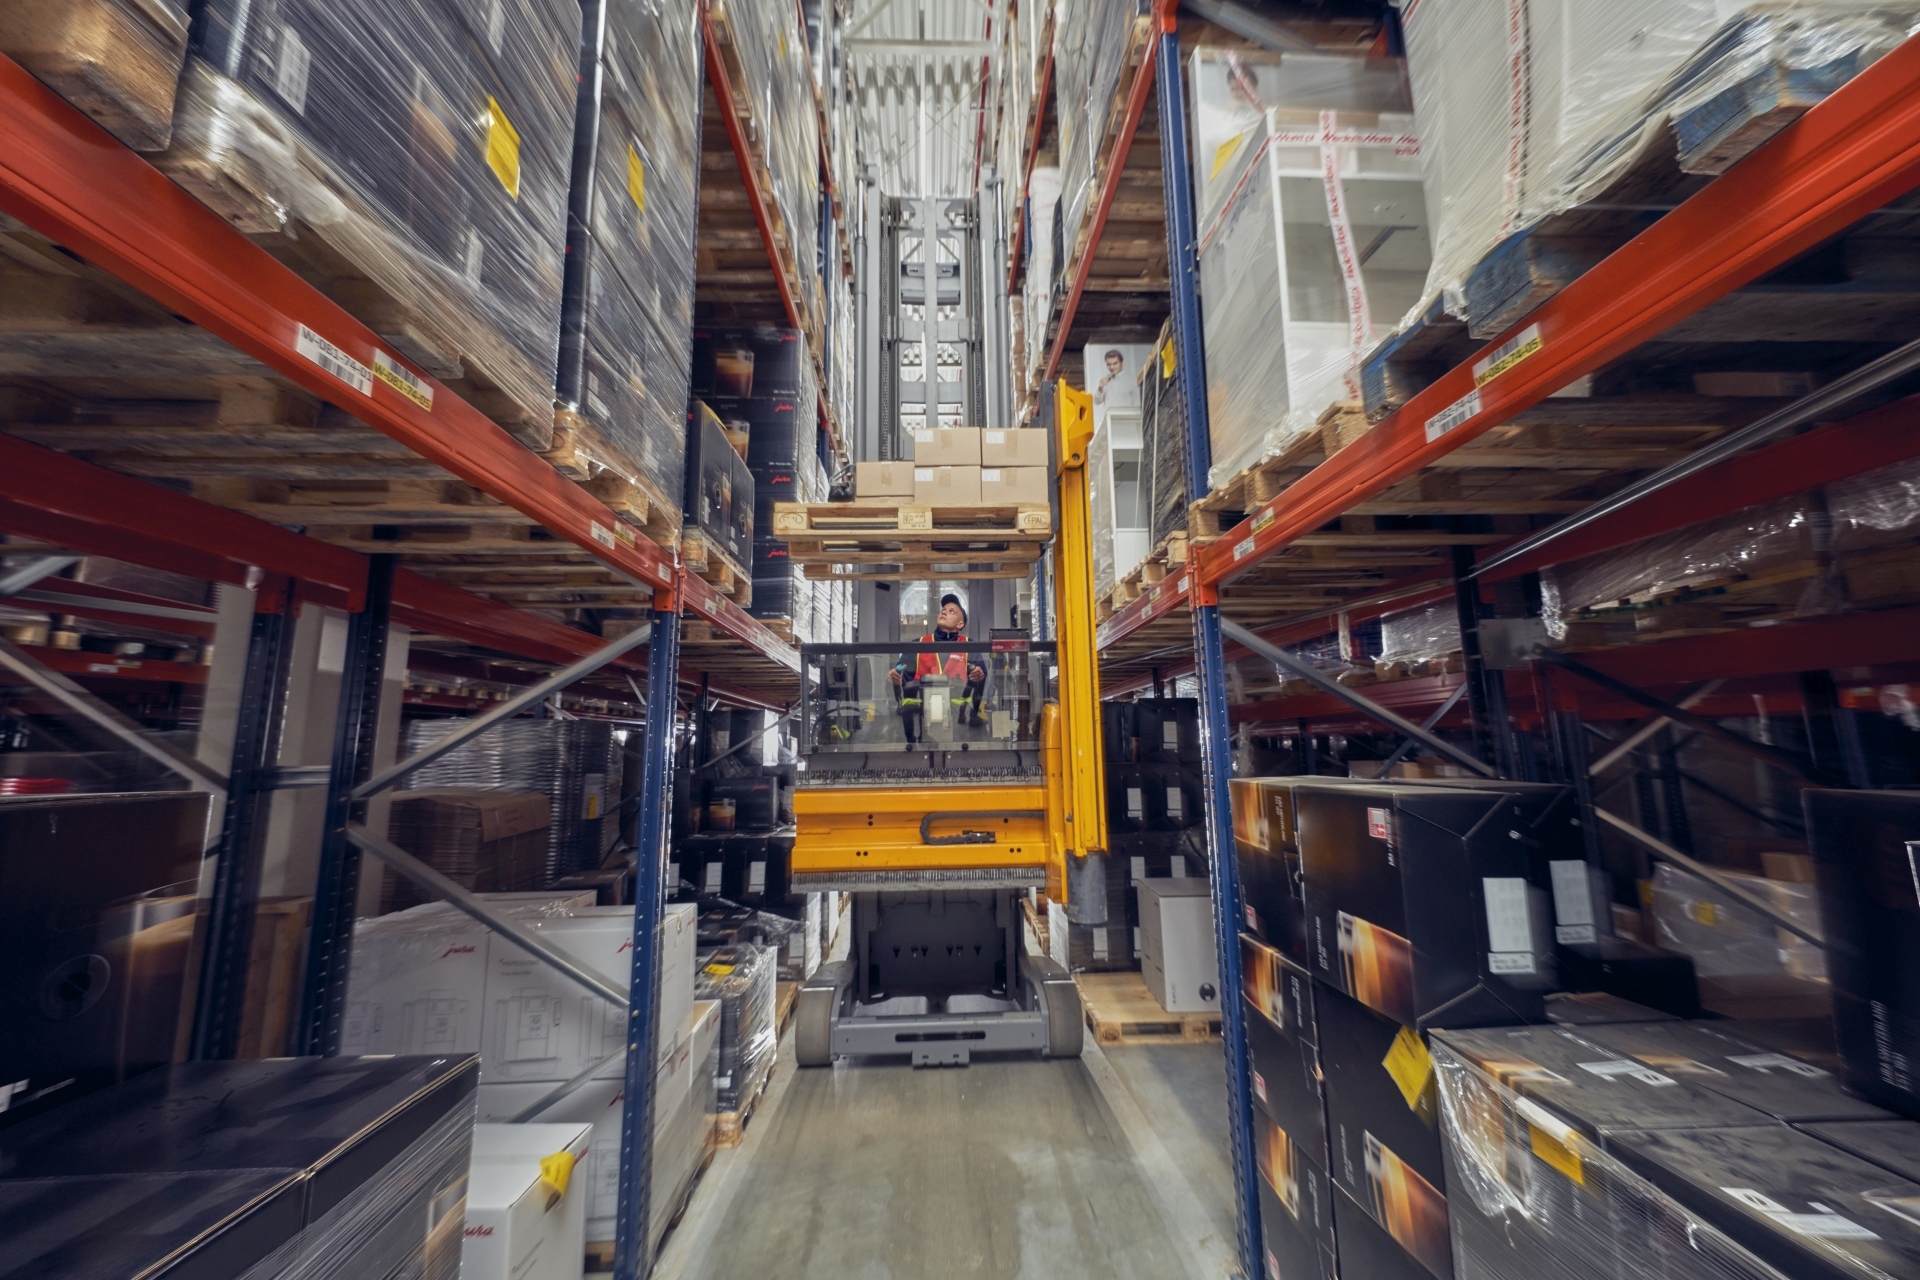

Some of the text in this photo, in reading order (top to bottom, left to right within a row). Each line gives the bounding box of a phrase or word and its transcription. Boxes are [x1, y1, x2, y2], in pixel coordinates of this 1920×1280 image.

[302, 326, 373, 382] W-081-74-01
[1475, 337, 1539, 384] W-082-74-05
[374, 363, 432, 409] W-081-74-05
[441, 943, 476, 959] jura
